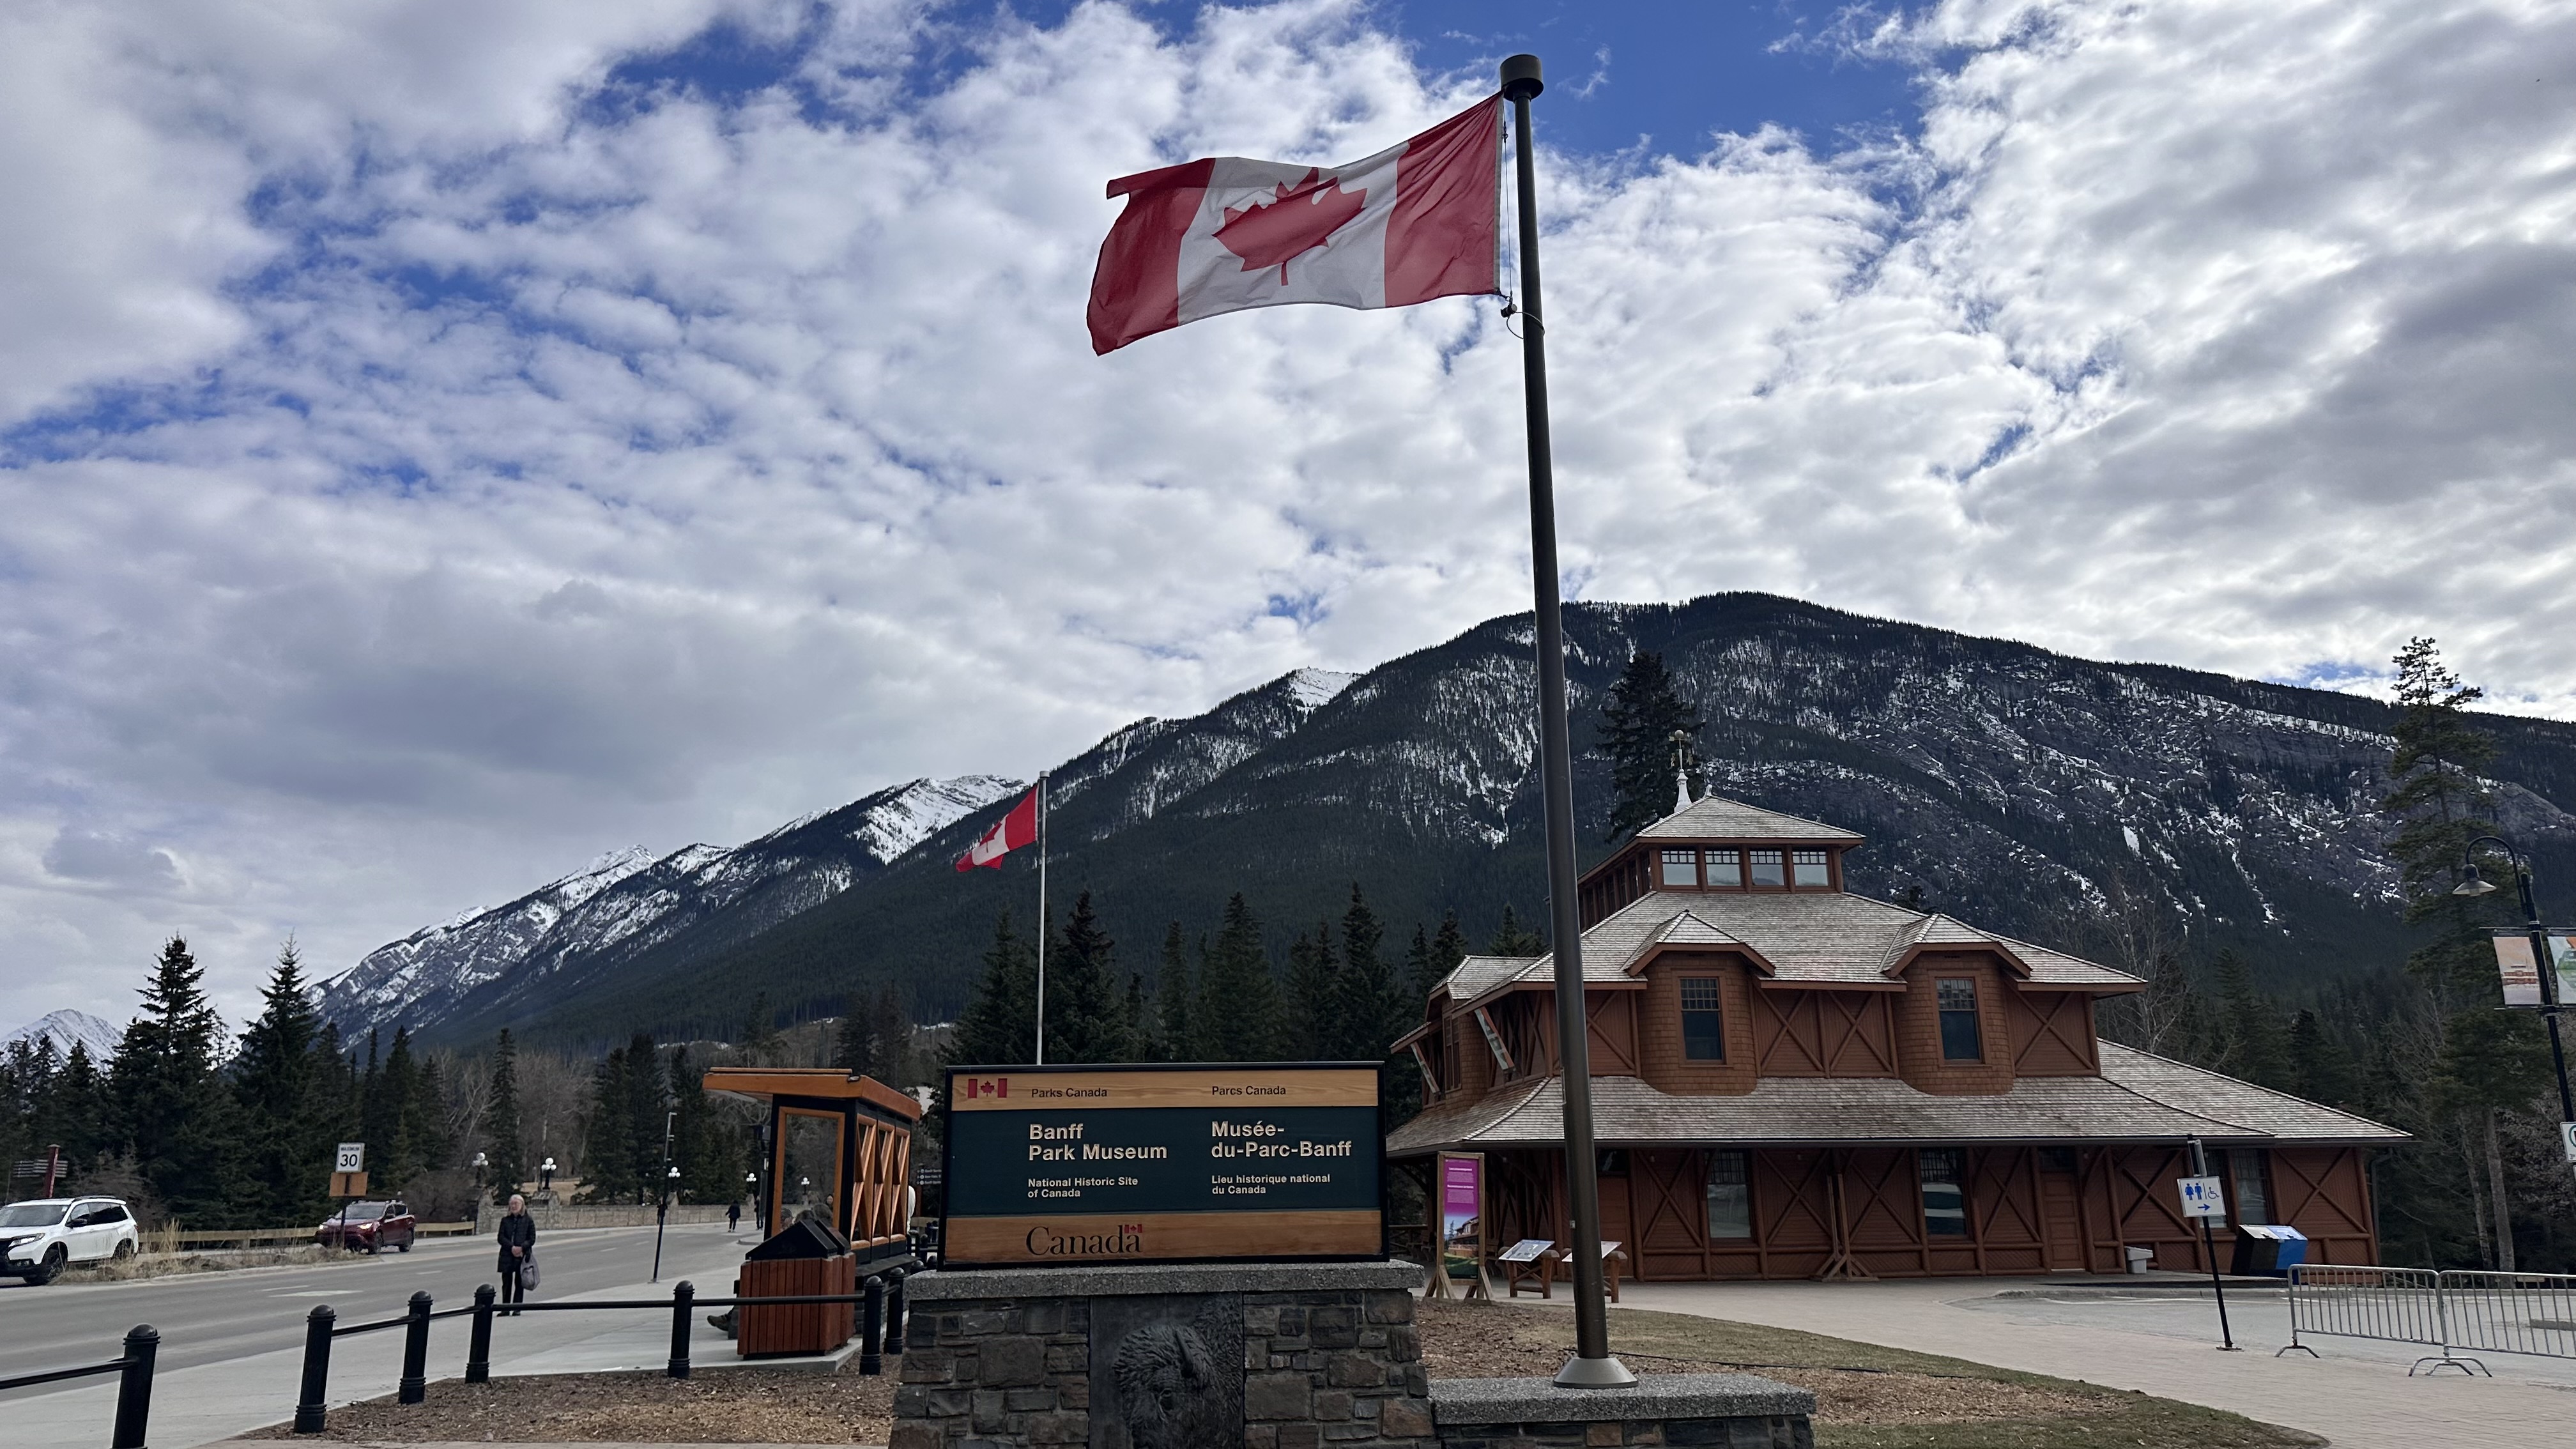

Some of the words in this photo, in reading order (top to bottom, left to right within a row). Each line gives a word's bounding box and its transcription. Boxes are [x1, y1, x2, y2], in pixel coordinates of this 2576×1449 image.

[1031, 1088, 1062, 1098] Parks
[1066, 1087, 1107, 1098] Canada
[1212, 1085, 1243, 1096] Parcs
[1245, 1085, 1286, 1095] Canada
[1029, 1123, 1084, 1140] Banff
[1211, 1121, 1285, 1137] Musée-
[1029, 1144, 1075, 1161] Park
[1082, 1143, 1167, 1160] Museum
[1211, 1140, 1352, 1157] du-Parc-Banff
[340, 1154, 358, 1167] 30
[1028, 1177, 1071, 1188] National
[1075, 1177, 1115, 1186] Historic
[1118, 1176, 1138, 1186] Site
[1211, 1175, 1233, 1184] Lieu
[1236, 1174, 1287, 1185] historique
[1290, 1174, 1330, 1183] national
[1027, 1189, 1039, 1198] of
[1041, 1188, 1081, 1198] Canada
[1211, 1186, 1225, 1194] du
[1228, 1185, 1266, 1194] Canada
[1026, 1224, 1142, 1255] Canada
